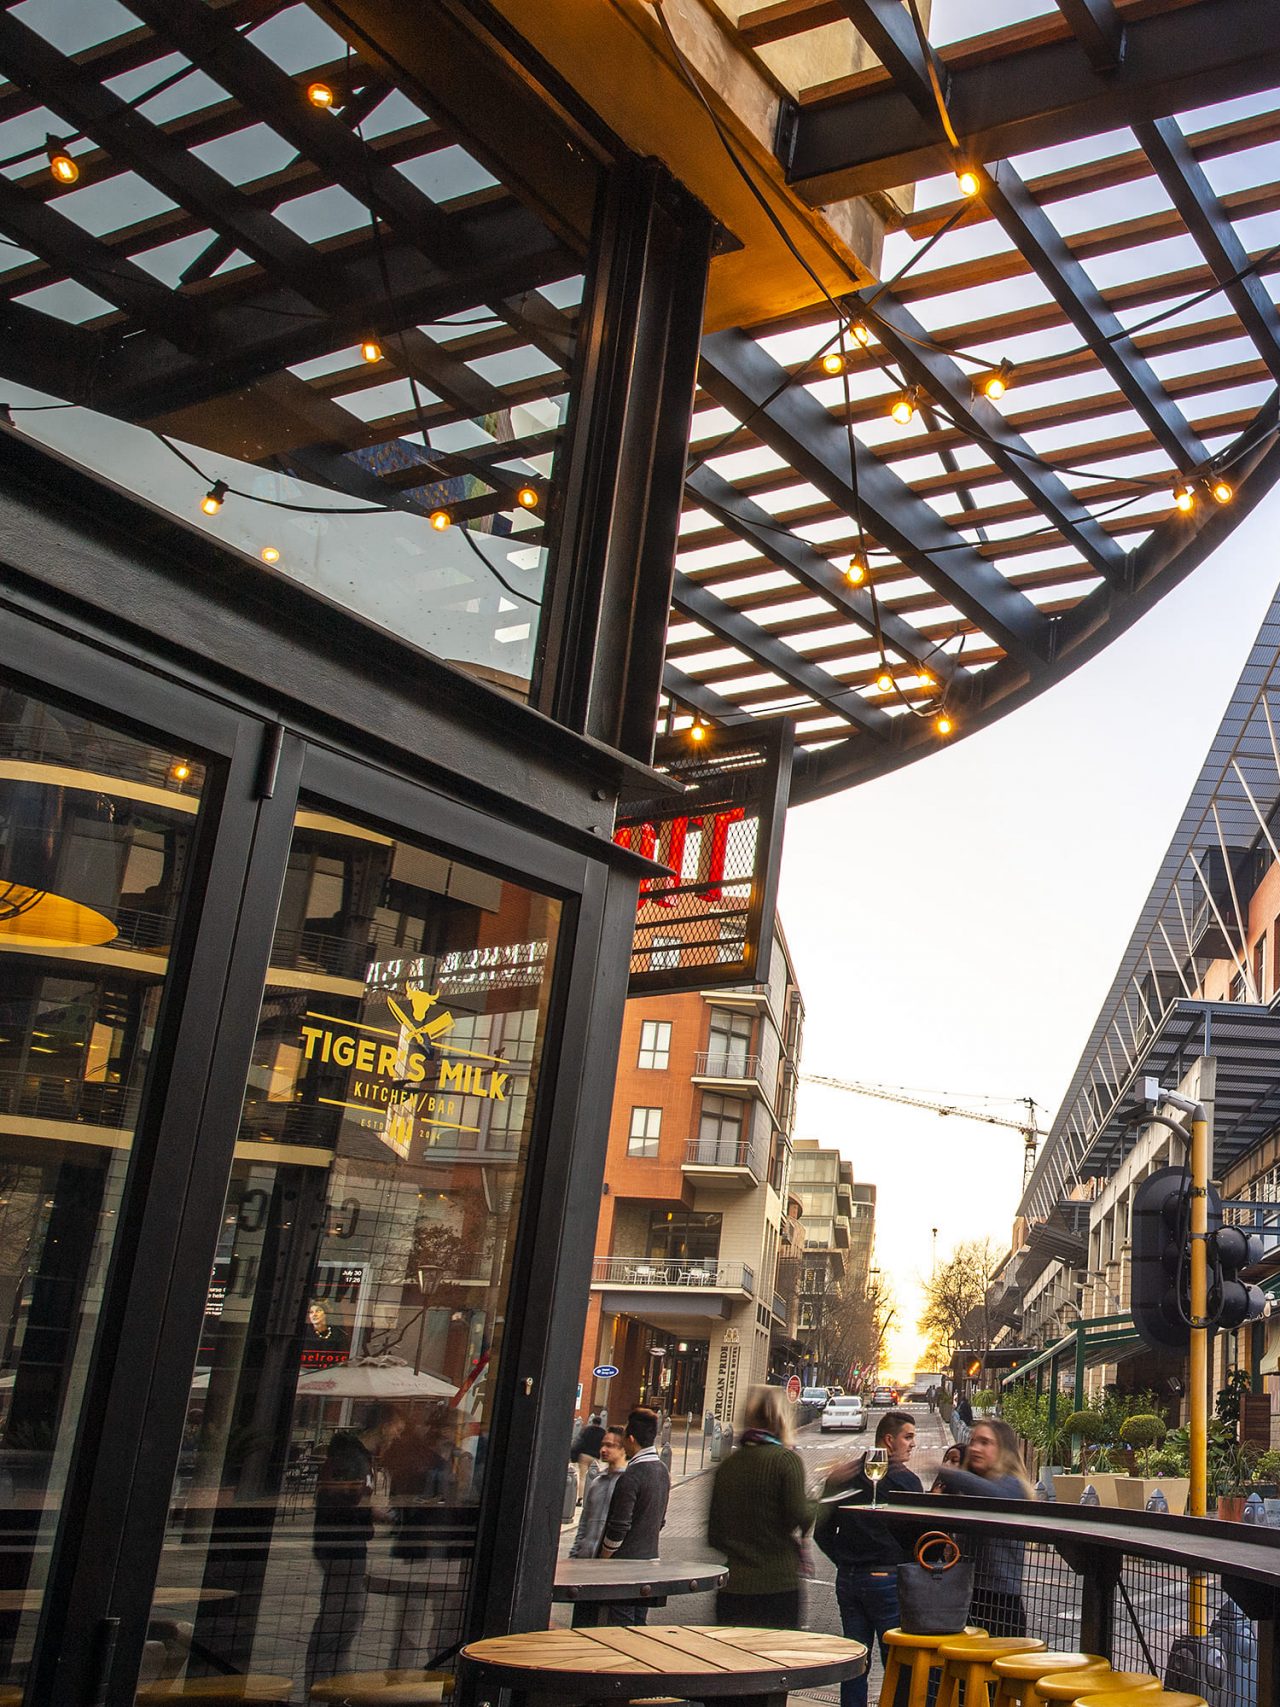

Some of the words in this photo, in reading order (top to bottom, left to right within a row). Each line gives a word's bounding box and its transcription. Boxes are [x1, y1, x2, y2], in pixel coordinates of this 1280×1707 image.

[301, 1025, 426, 1082] TIGER'S
[439, 1059, 509, 1101] MILK
[354, 1081, 455, 1115] KITCHEN/BAR
[360, 1119, 384, 1130] ESTD
[719, 1346, 729, 1375] PRIDE
[714, 1377, 725, 1421] AFRICAN
